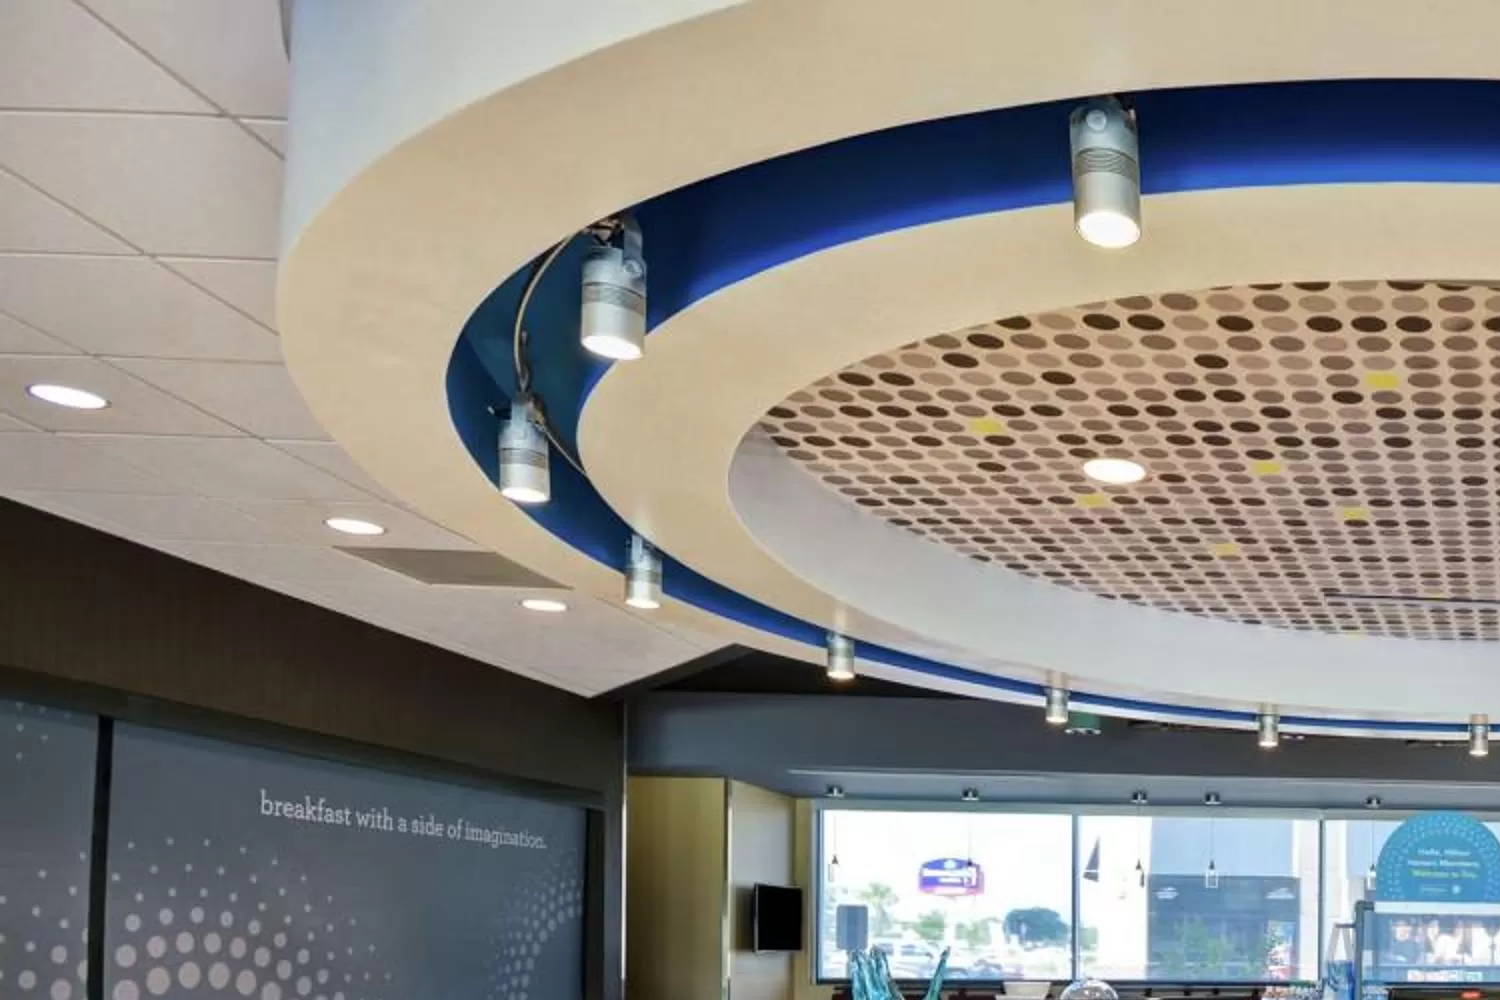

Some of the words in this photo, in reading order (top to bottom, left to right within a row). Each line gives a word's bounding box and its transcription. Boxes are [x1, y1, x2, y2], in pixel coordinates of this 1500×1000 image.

[260, 788, 352, 826] breakfast
[355, 807, 394, 833] with
[397, 817, 408, 833] a
[411, 815, 444, 837] side
[447, 819, 464, 840] of
[464, 821, 548, 849] imagination.
